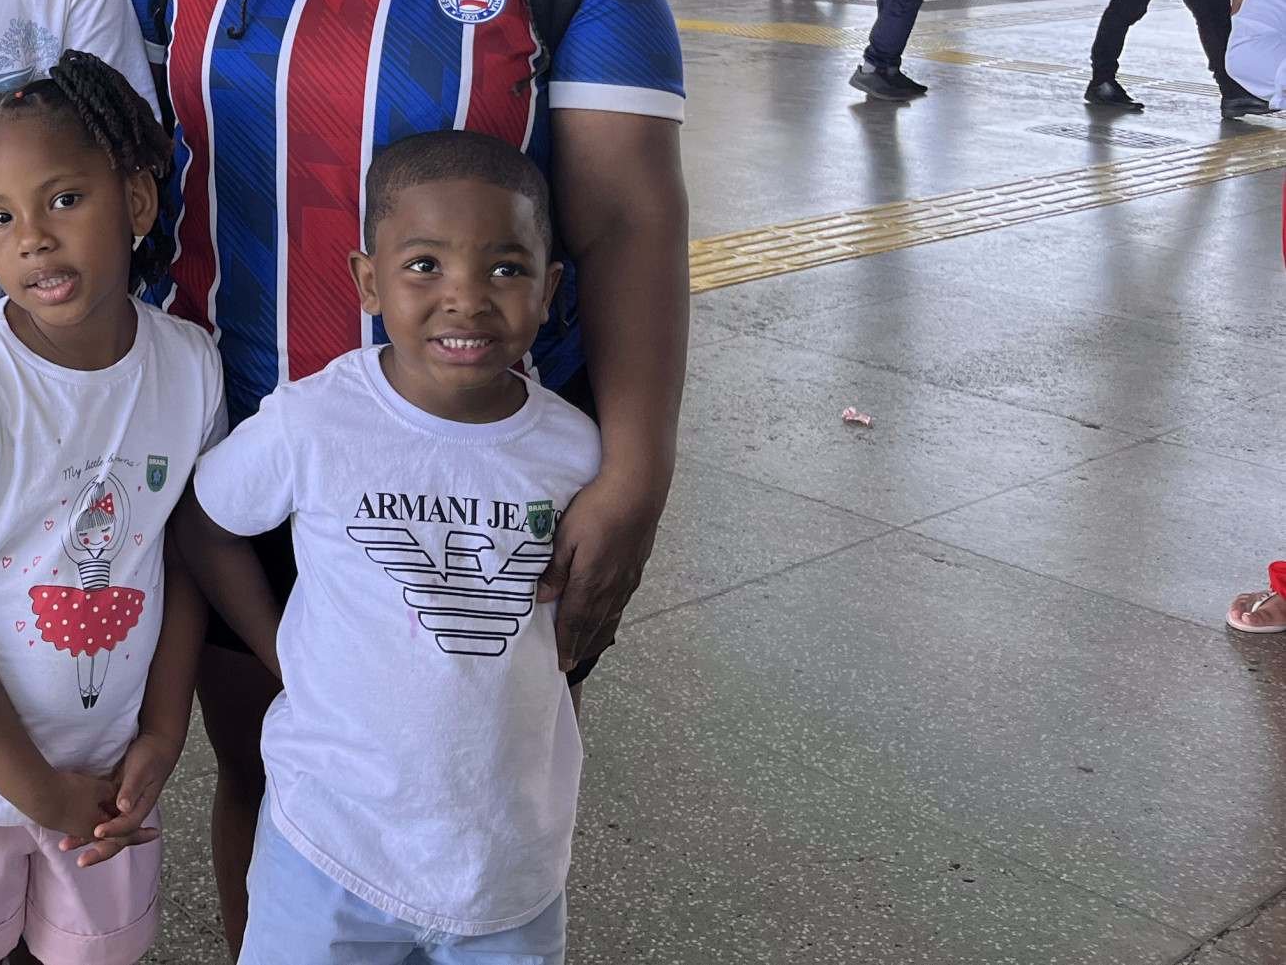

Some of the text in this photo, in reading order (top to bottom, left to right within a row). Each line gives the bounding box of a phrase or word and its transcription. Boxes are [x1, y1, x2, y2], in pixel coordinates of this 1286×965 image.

[62, 466, 82, 480] My
[353, 491, 480, 527] ARMANI
[528, 503, 552, 512] BRASIL
